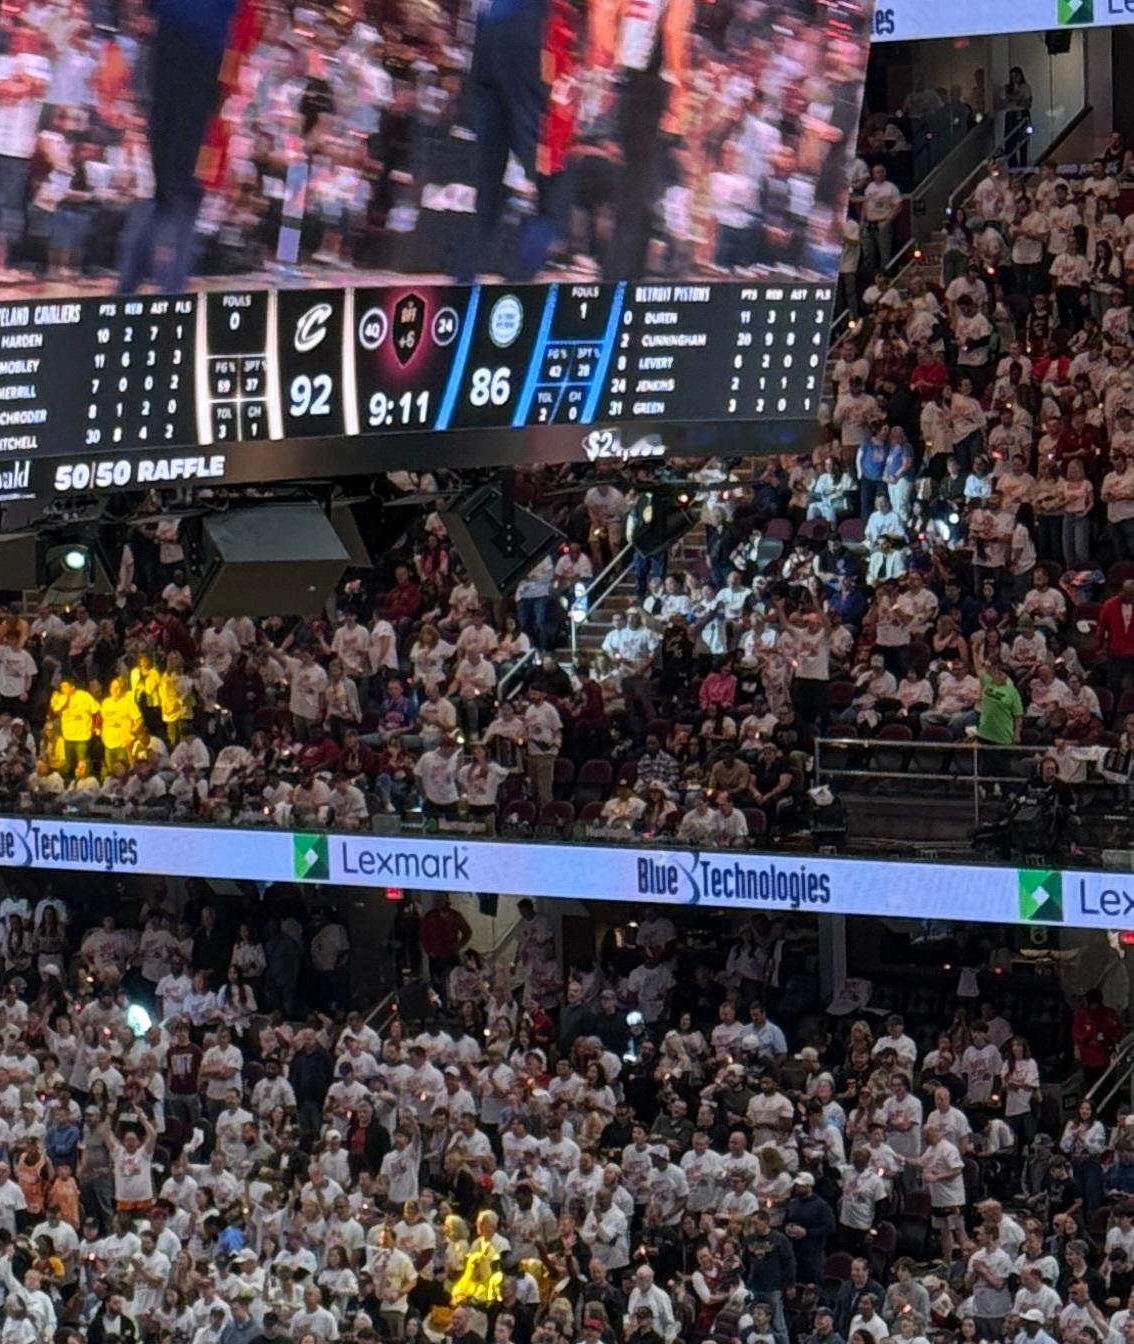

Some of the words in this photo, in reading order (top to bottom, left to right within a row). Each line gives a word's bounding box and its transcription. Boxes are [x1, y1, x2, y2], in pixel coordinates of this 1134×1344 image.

[99, 304, 116, 316] PTS
[151, 302, 168, 314] AST
[223, 295, 251, 307] FOULS
[581, 303, 587, 318] 1
[624, 311, 632, 325] 0
[230, 312, 240, 329] 0
[437, 317, 453, 333] 24
[1, 334, 42, 348] HARDEN
[98, 329, 109, 343] 10
[151, 326, 158, 340] 7
[177, 326, 182, 338] 1
[621, 333, 629, 347] 2
[737, 333, 751, 346] 20
[0, 360, 39, 374] MOBLEY
[95, 354, 105, 368] 11
[784, 355, 792, 367] 0
[810, 354, 818, 367] 0
[92, 379, 99, 393] 7
[119, 378, 127, 392] 0
[145, 376, 153, 390] 0
[170, 375, 178, 389] 2
[807, 376, 814, 389] 2
[290, 374, 332, 416] 92
[368, 390, 430, 427] 9:11
[470, 366, 511, 406] 86
[117, 403, 122, 416] 1
[142, 401, 150, 415] 2
[168, 400, 176, 413] 0
[569, 407, 577, 420] 0
[609, 401, 622, 415] 31
[778, 399, 786, 411] 0
[86, 429, 100, 444] 30
[139, 427, 147, 439] 4
[165, 424, 173, 438] 2
[252, 423, 257, 435] 1
[54, 460, 131, 491] 50/50
[137, 456, 225, 482] RAFFLE
[31, 825, 139, 870] Technologies
[341, 846, 469, 881] Lexmark
[637, 855, 679, 897] Blue
[699, 859, 831, 906] Technologies
